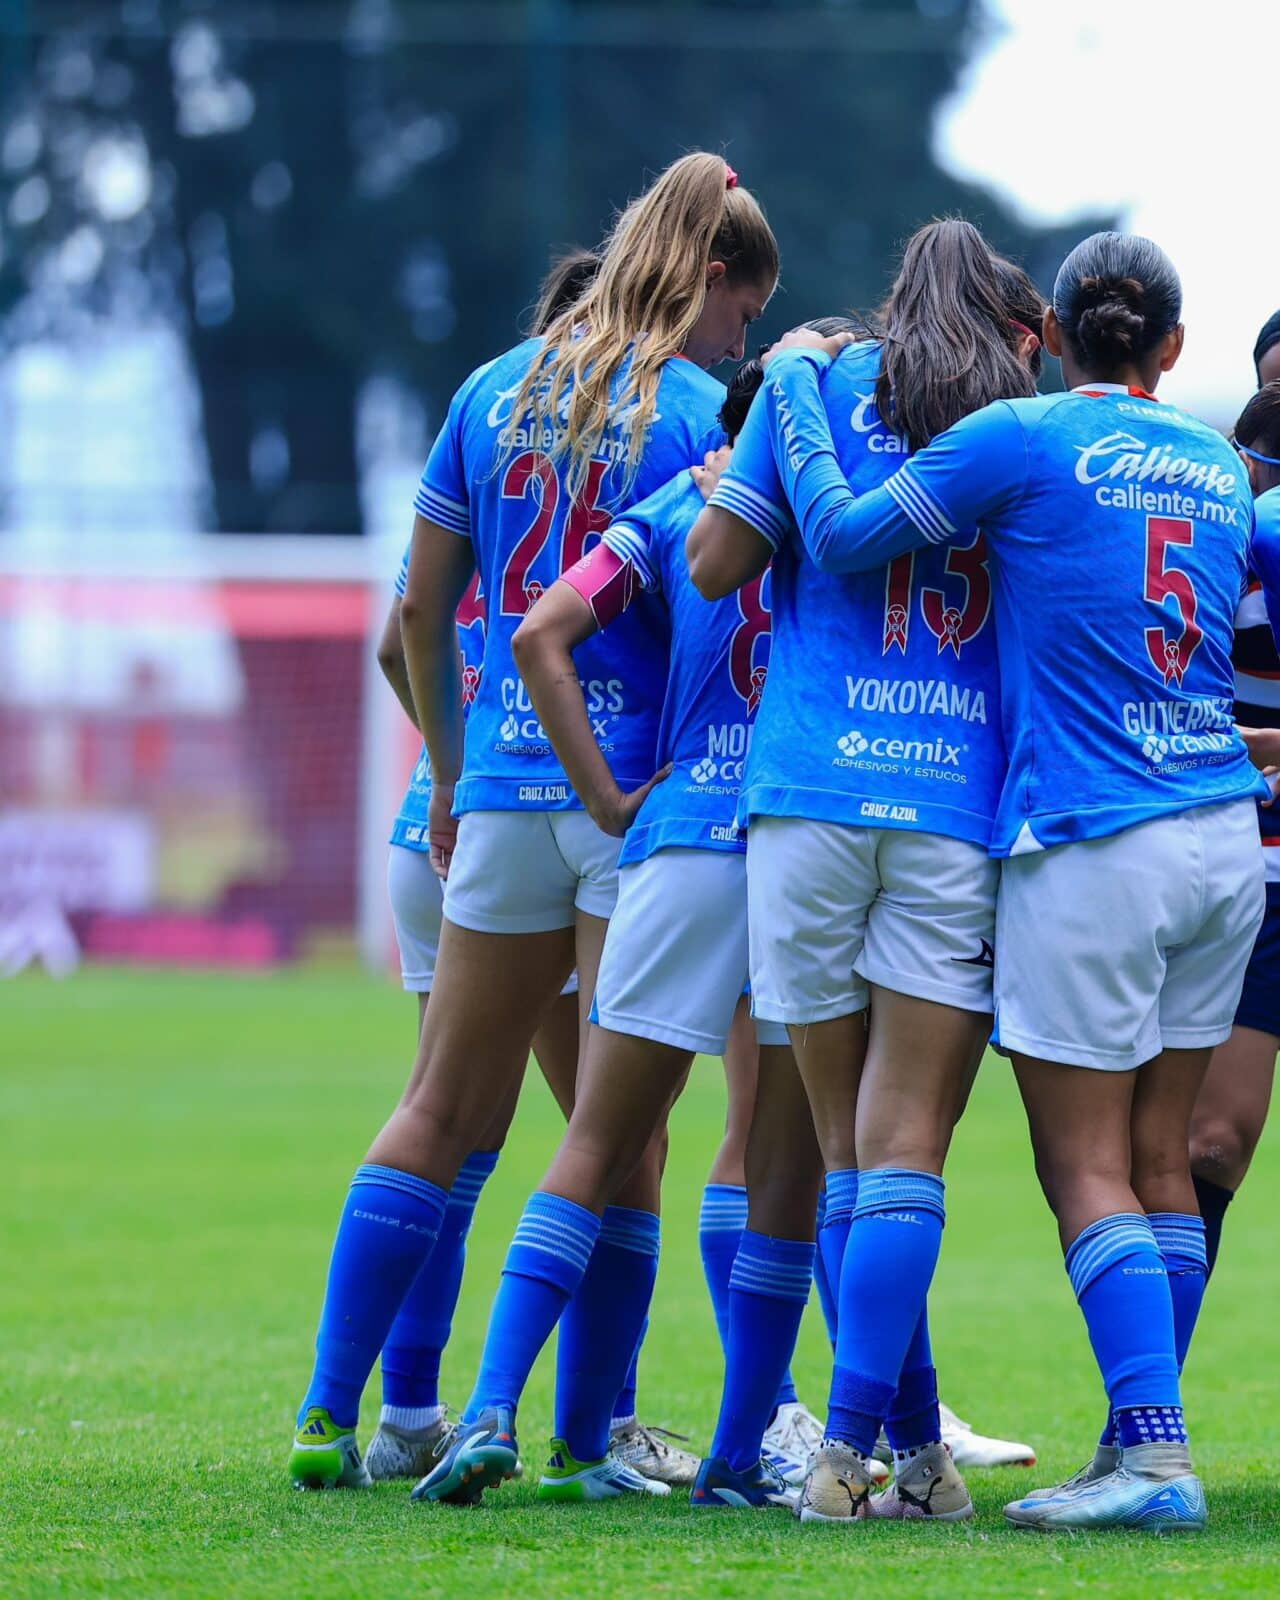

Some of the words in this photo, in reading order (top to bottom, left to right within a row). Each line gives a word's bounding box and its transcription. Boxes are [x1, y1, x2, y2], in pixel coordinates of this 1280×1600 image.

[1072, 430, 1236, 496] Caliente
[1095, 483, 1239, 526] caliente.mx
[1143, 515, 1203, 686] 5
[845, 675, 987, 725] YOKOYAMA
[494, 743, 551, 755] ADHESIVOS
[870, 737, 961, 766] cemix
[1170, 730, 1233, 755] cemix
[831, 757, 899, 774] ADHESIVOS
[903, 766, 912, 775] Y
[914, 767, 968, 785] ESTUCOS
[1145, 759, 1198, 777] ADHESIVOS
[519, 785, 543, 800] CRUZ
[545, 786, 568, 800] AZUL
[685, 784, 742, 796] ADHESIVO
[860, 801, 889, 818] CRUZ
[889, 805, 919, 822] AZUL
